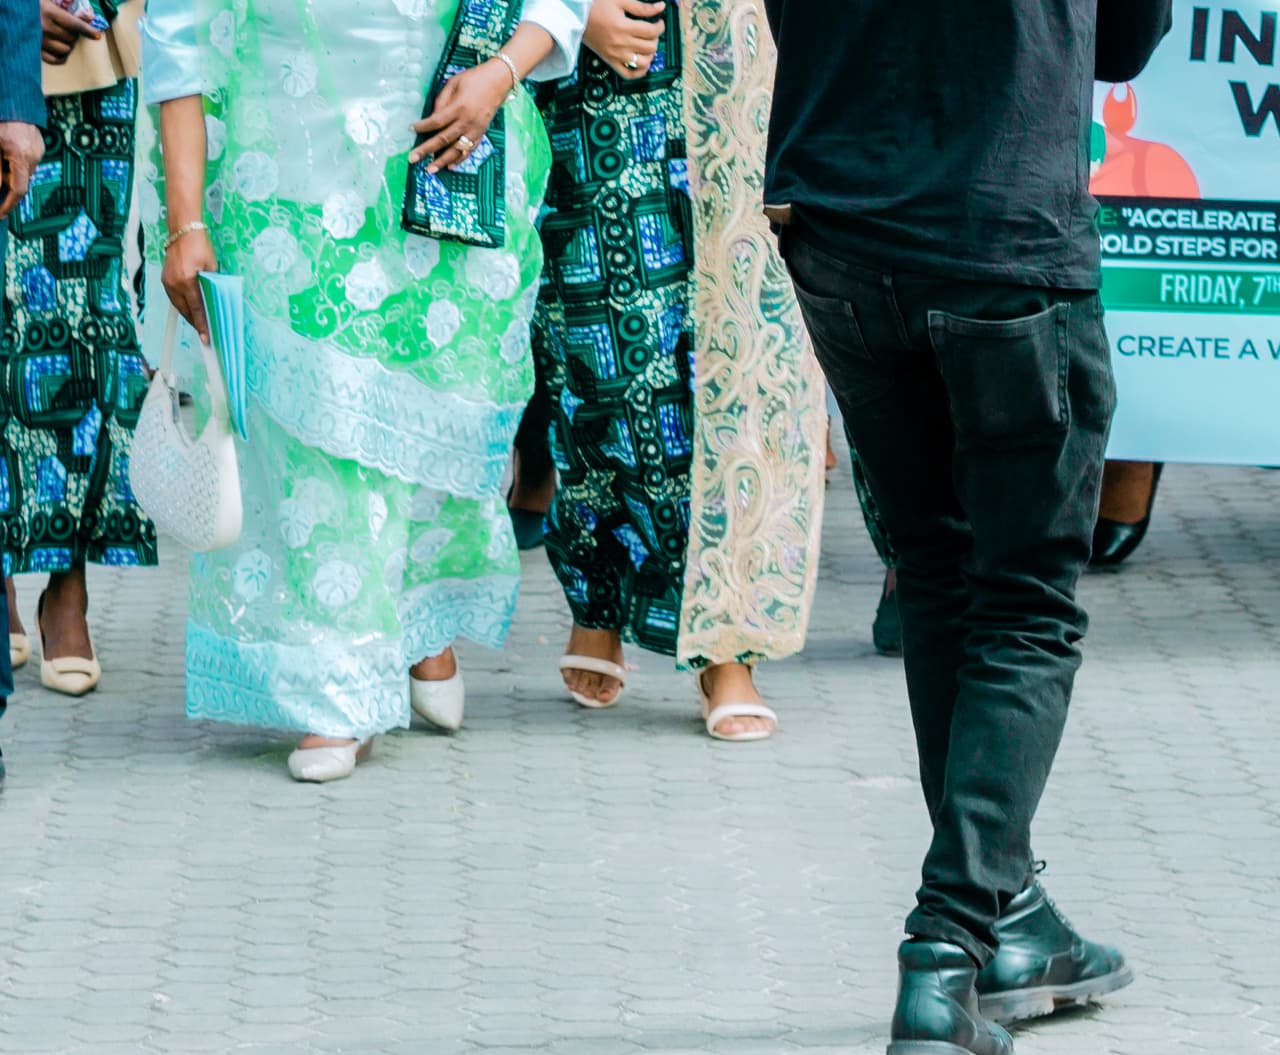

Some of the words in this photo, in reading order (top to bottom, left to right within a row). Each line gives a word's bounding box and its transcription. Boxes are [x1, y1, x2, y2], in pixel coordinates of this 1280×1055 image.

[1122, 207, 1277, 232] "ACCELERATE
[1100, 234, 1153, 256] OLD
[1155, 235, 1226, 258] STEPS
[1230, 237, 1278, 259] FOR
[1160, 273, 1246, 309] FRIDAY,
[1117, 335, 1230, 360] CREATE
[1237, 338, 1260, 360] A
